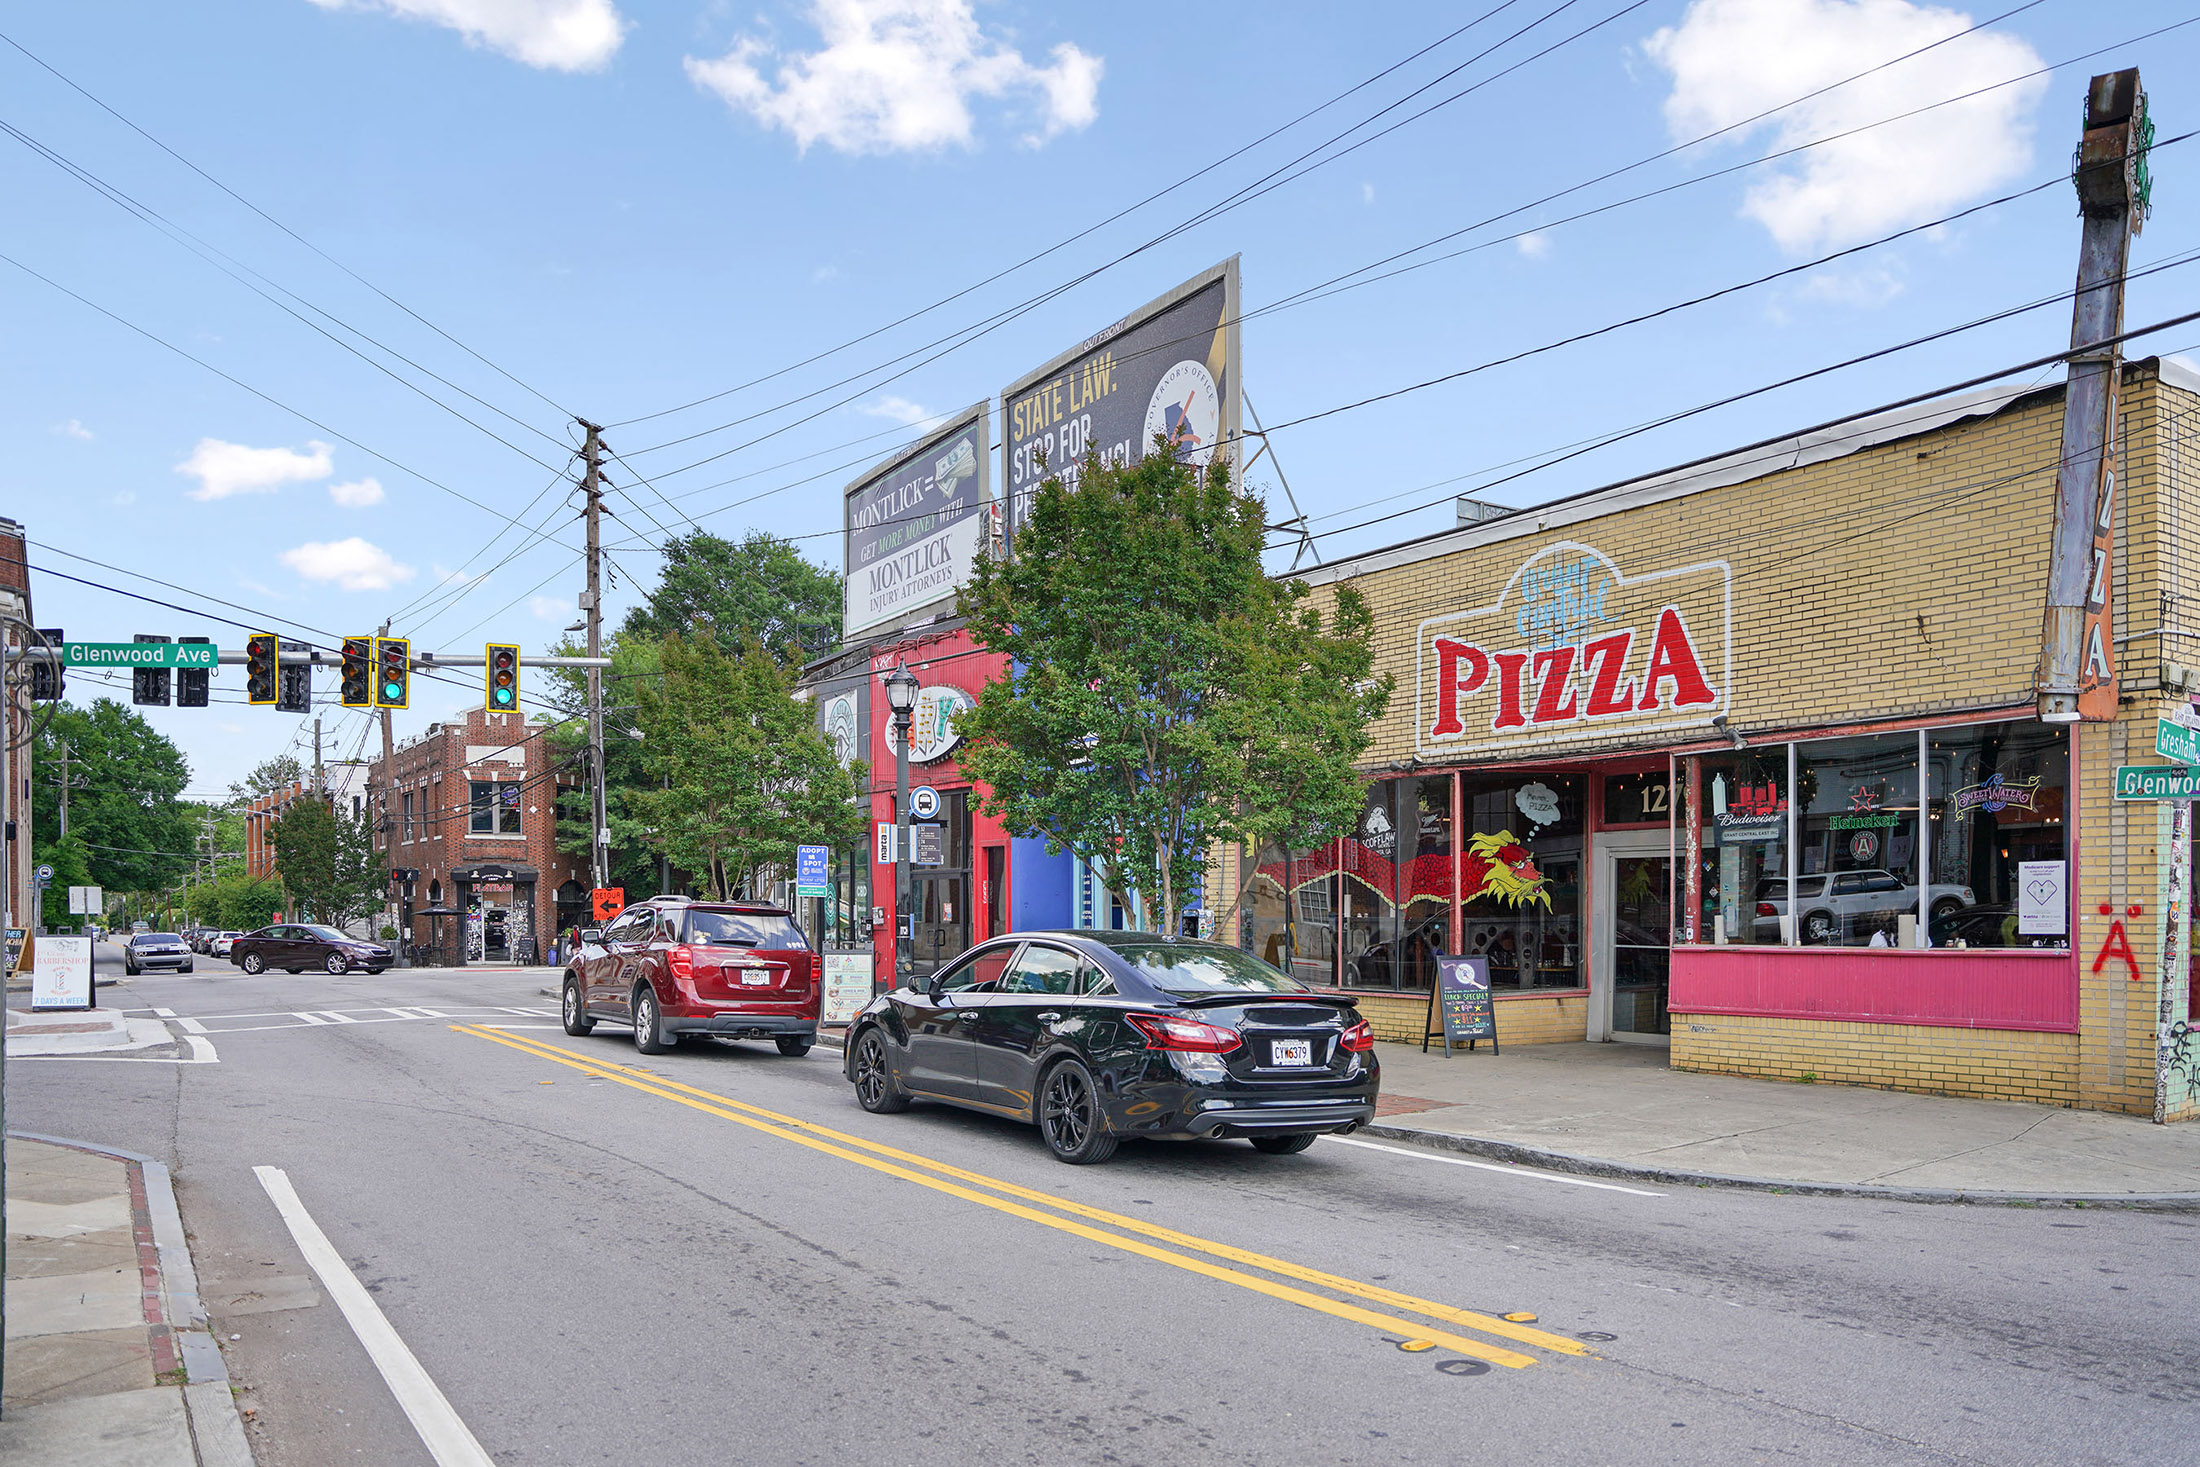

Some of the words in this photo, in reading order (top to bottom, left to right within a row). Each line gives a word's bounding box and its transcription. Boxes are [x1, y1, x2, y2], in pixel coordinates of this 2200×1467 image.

[1014, 379, 1062, 442] STATE
[1070, 352, 1117, 414] LAW:
[1147, 366, 1188, 430] GOVERNOR'S
[1191, 367, 1214, 402] OFFICE
[1014, 433, 1054, 485] STOP
[1060, 413, 1092, 464] FOR
[852, 476, 923, 536] MONTLICK
[860, 541, 878, 563] GET
[877, 528, 903, 555] MORE
[904, 512, 937, 545] MONEY
[939, 497, 964, 526] WITH
[869, 534, 952, 595] MONTLICK
[870, 588, 899, 613] INJURY
[901, 565, 952, 599] ATTORNEYS
[70, 645, 164, 662] Glenwood
[175, 646, 211, 663] Ave
[1432, 608, 1716, 738] PIZZA
[2161, 726, 2196, 759] Gresham
[1528, 801, 1553, 811] PIZZA
[1641, 783, 1687, 813] 127
[1717, 813, 1781, 827] Budweiser
[1829, 813, 1899, 830] Heineken
[857, 885, 867, 897] CBD
[36, 957, 88, 965] BARBERSHOP
[34, 997, 38, 1005] 7
[40, 997, 58, 1005] DAYS
[59, 997, 65, 1005] A
[65, 996, 87, 1004] WEEK!
